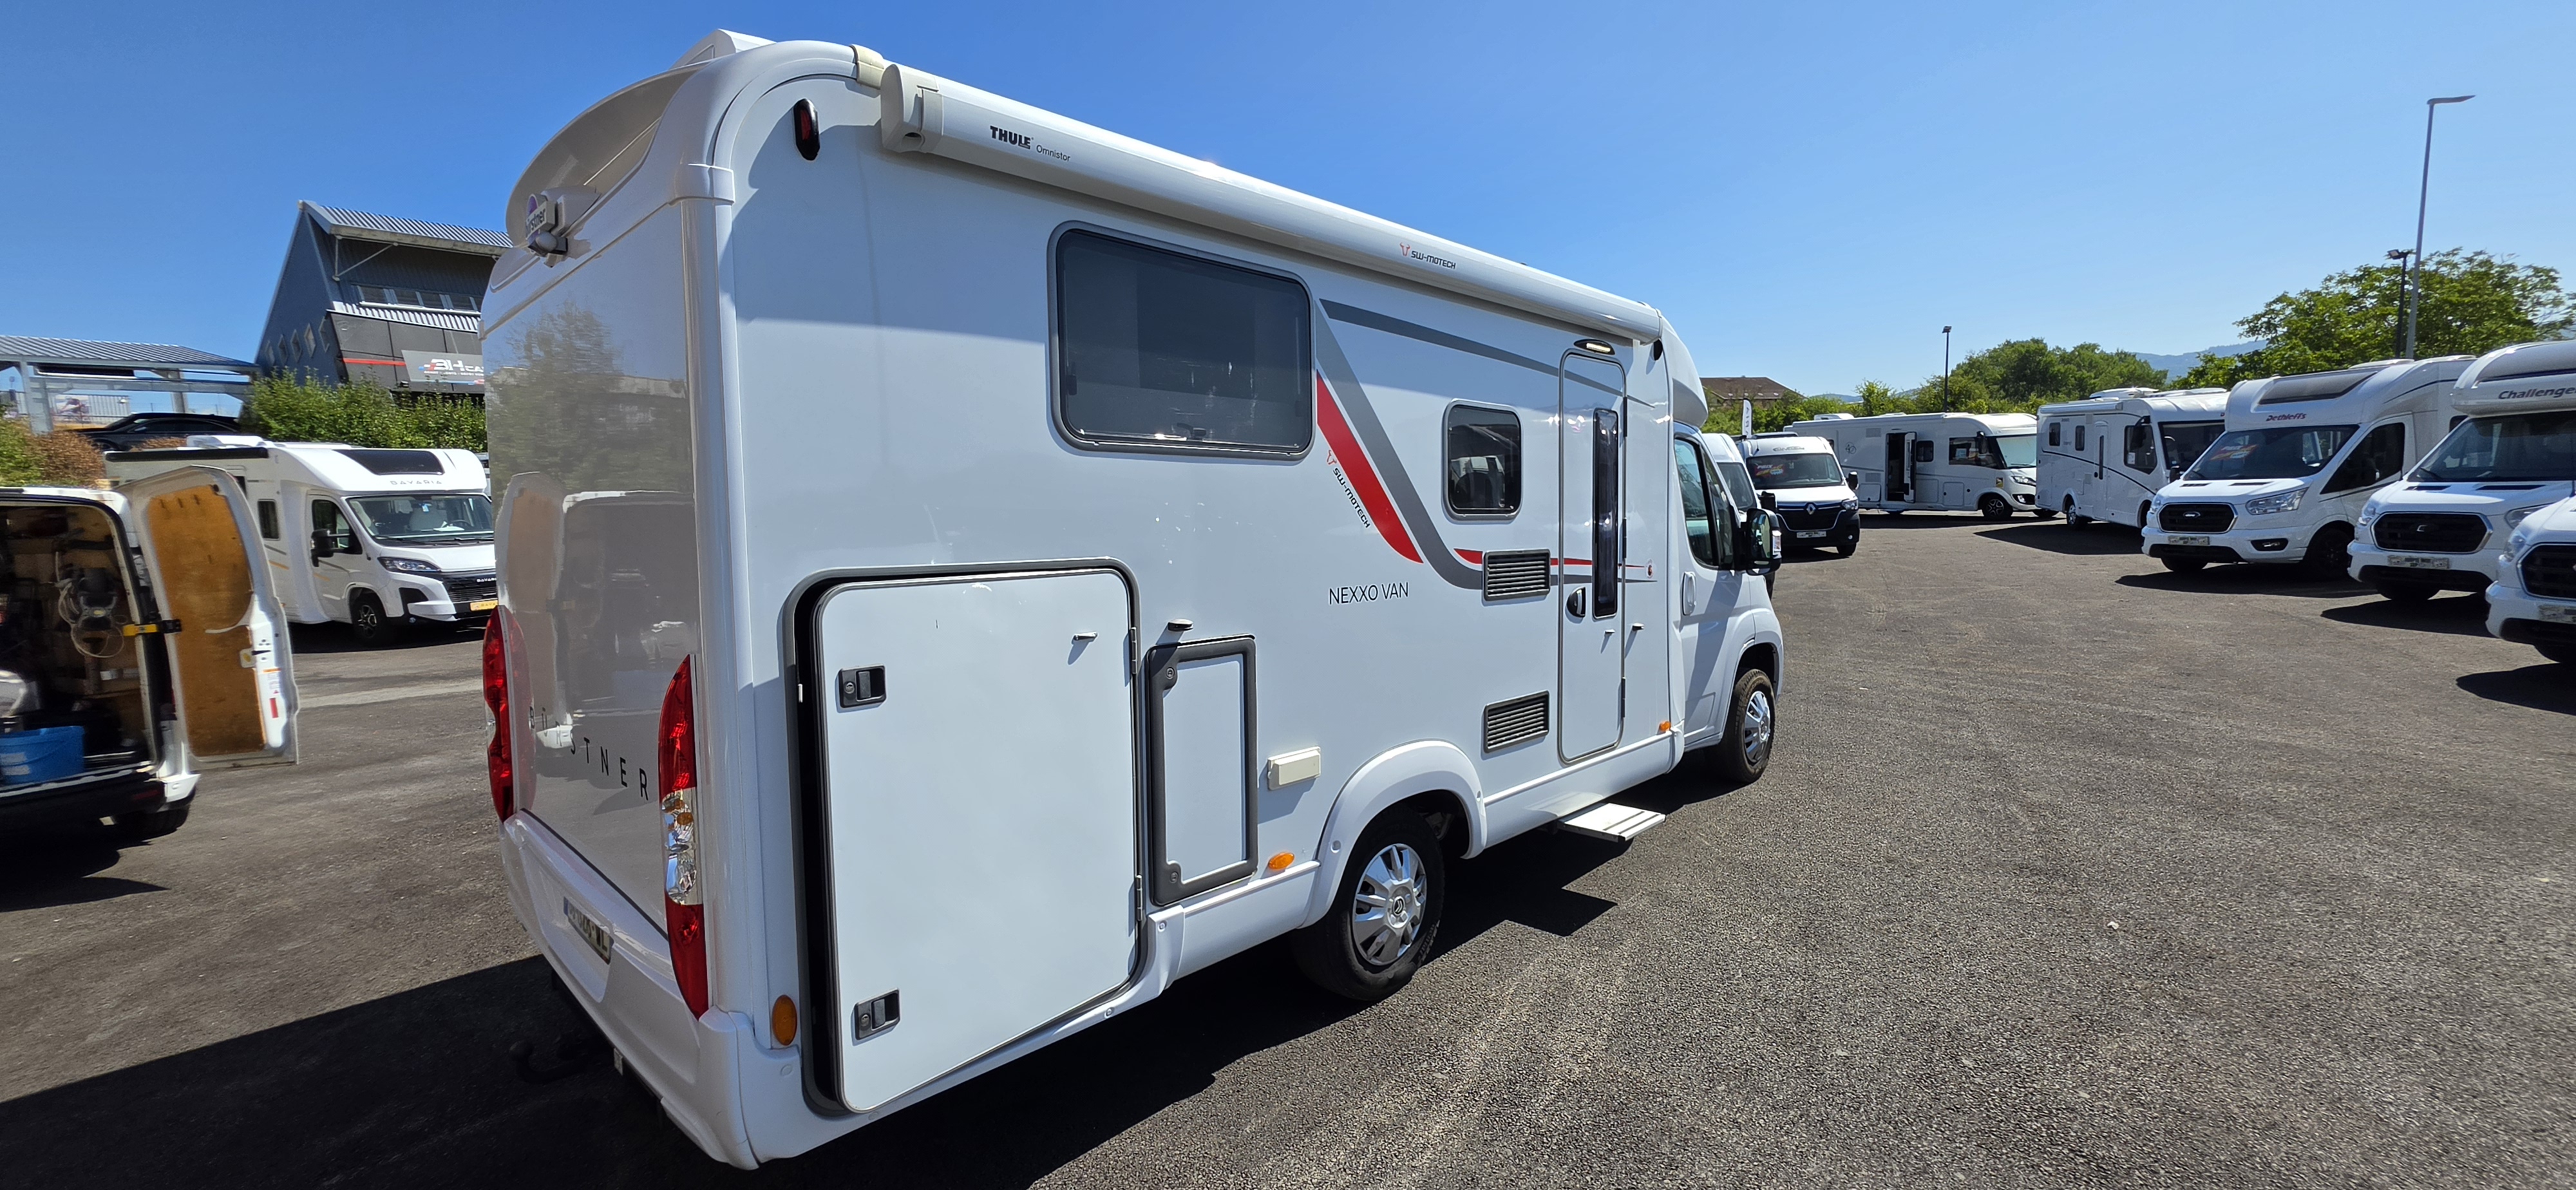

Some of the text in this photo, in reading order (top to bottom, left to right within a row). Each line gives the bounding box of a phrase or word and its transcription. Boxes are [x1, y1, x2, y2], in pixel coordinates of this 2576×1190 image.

[990, 126, 1070, 162] THULE Omnistor
[1411, 250, 1456, 269] SW-MOTECH
[2498, 387, 2576, 399] Challenge
[1332, 468, 1371, 528] SW-MOTECH
[1329, 581, 1408, 605] NEXXO VAN
